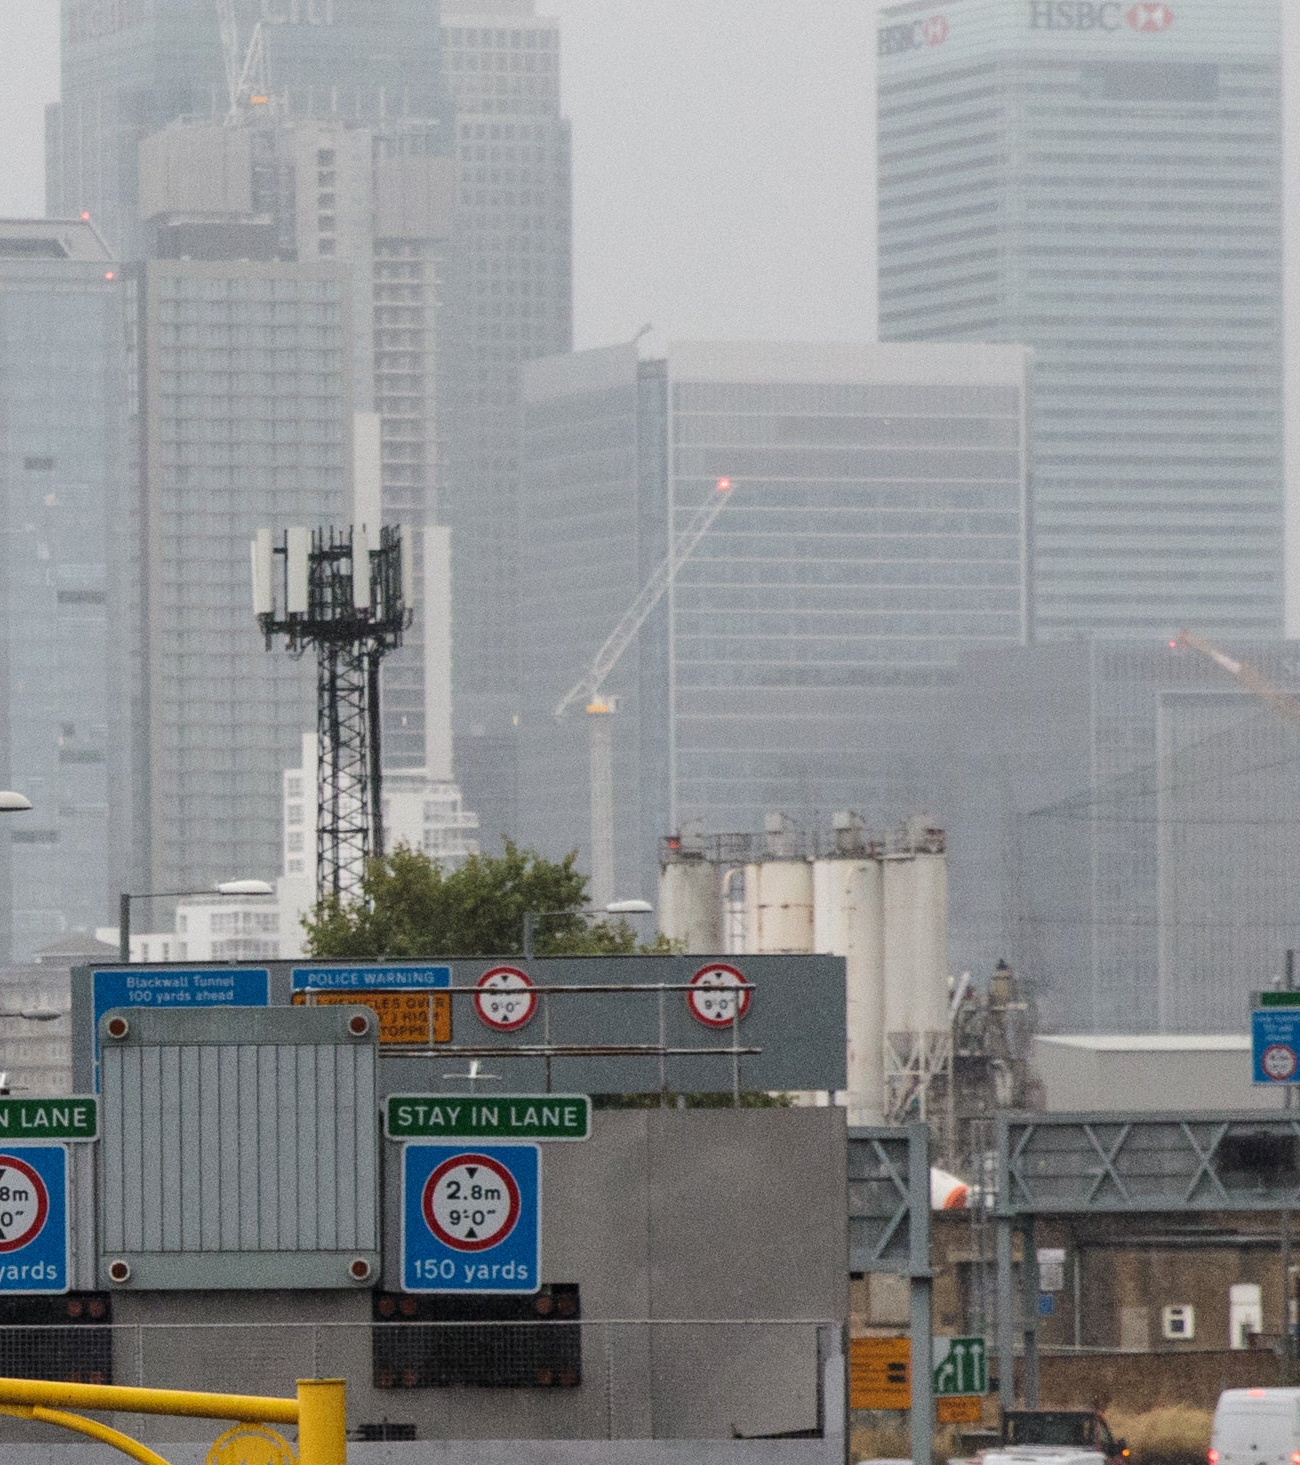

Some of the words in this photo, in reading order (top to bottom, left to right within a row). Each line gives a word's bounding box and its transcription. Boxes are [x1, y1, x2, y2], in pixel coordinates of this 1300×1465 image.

[1030, 0, 1123, 31] HSBC
[127, 976, 189, 989] Blackwall
[194, 975, 235, 987] Tunnel
[308, 973, 358, 986] POLICE
[364, 972, 436, 985] WARNING
[157, 989, 191, 1003] yards
[195, 989, 235, 1001] ahead
[21, 1107, 87, 1127] LANE
[398, 1106, 461, 1126] STAY
[471, 1107, 498, 1127] IN
[510, 1107, 577, 1127] LANE
[446, 1181, 501, 1200] 2.8m
[414, 1259, 456, 1279] 150
[464, 1259, 528, 1283] yards
